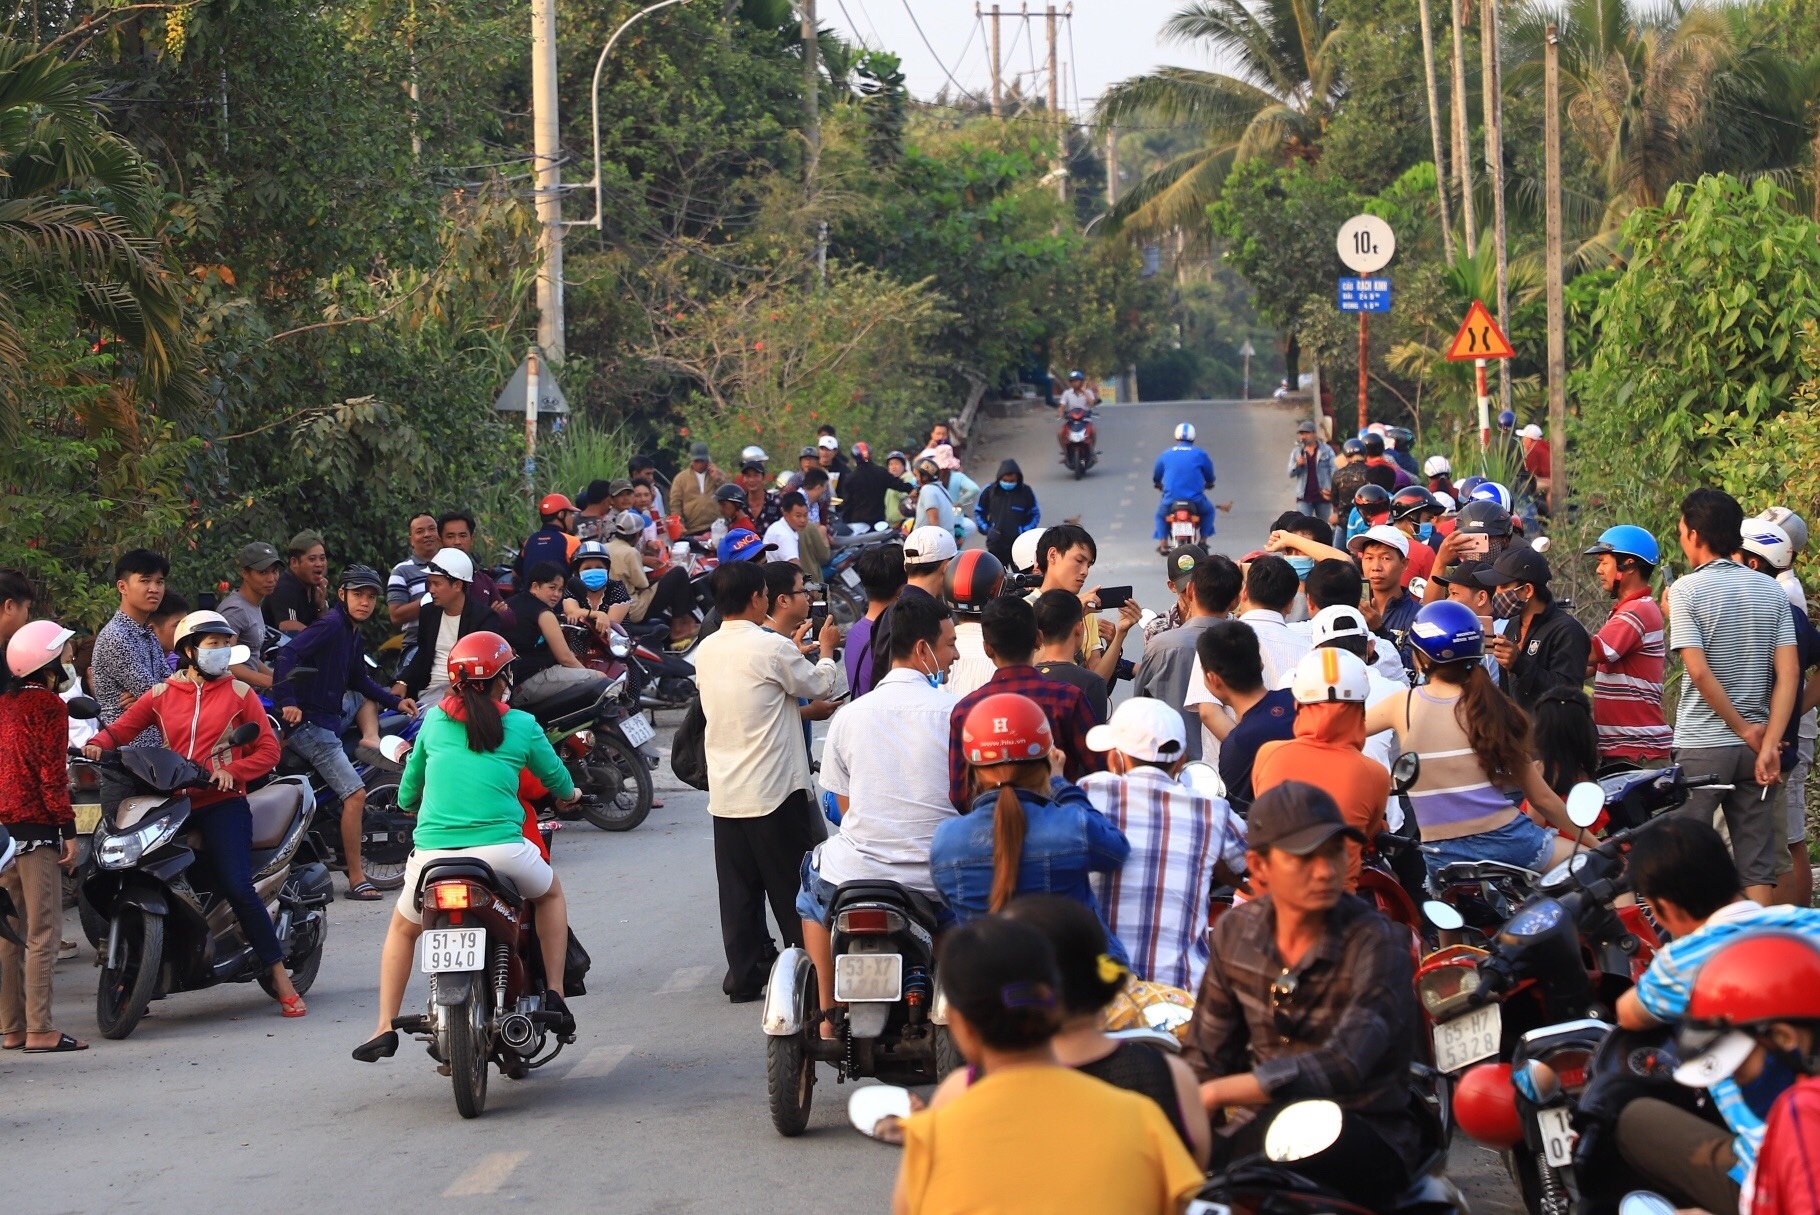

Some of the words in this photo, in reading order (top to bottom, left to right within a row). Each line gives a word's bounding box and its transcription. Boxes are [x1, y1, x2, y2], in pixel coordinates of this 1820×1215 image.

[992, 717, 1008, 733] H
[433, 932, 476, 949] 51-Y9
[432, 951, 475, 968] 9940
[1447, 1033, 1493, 1067] 5328
